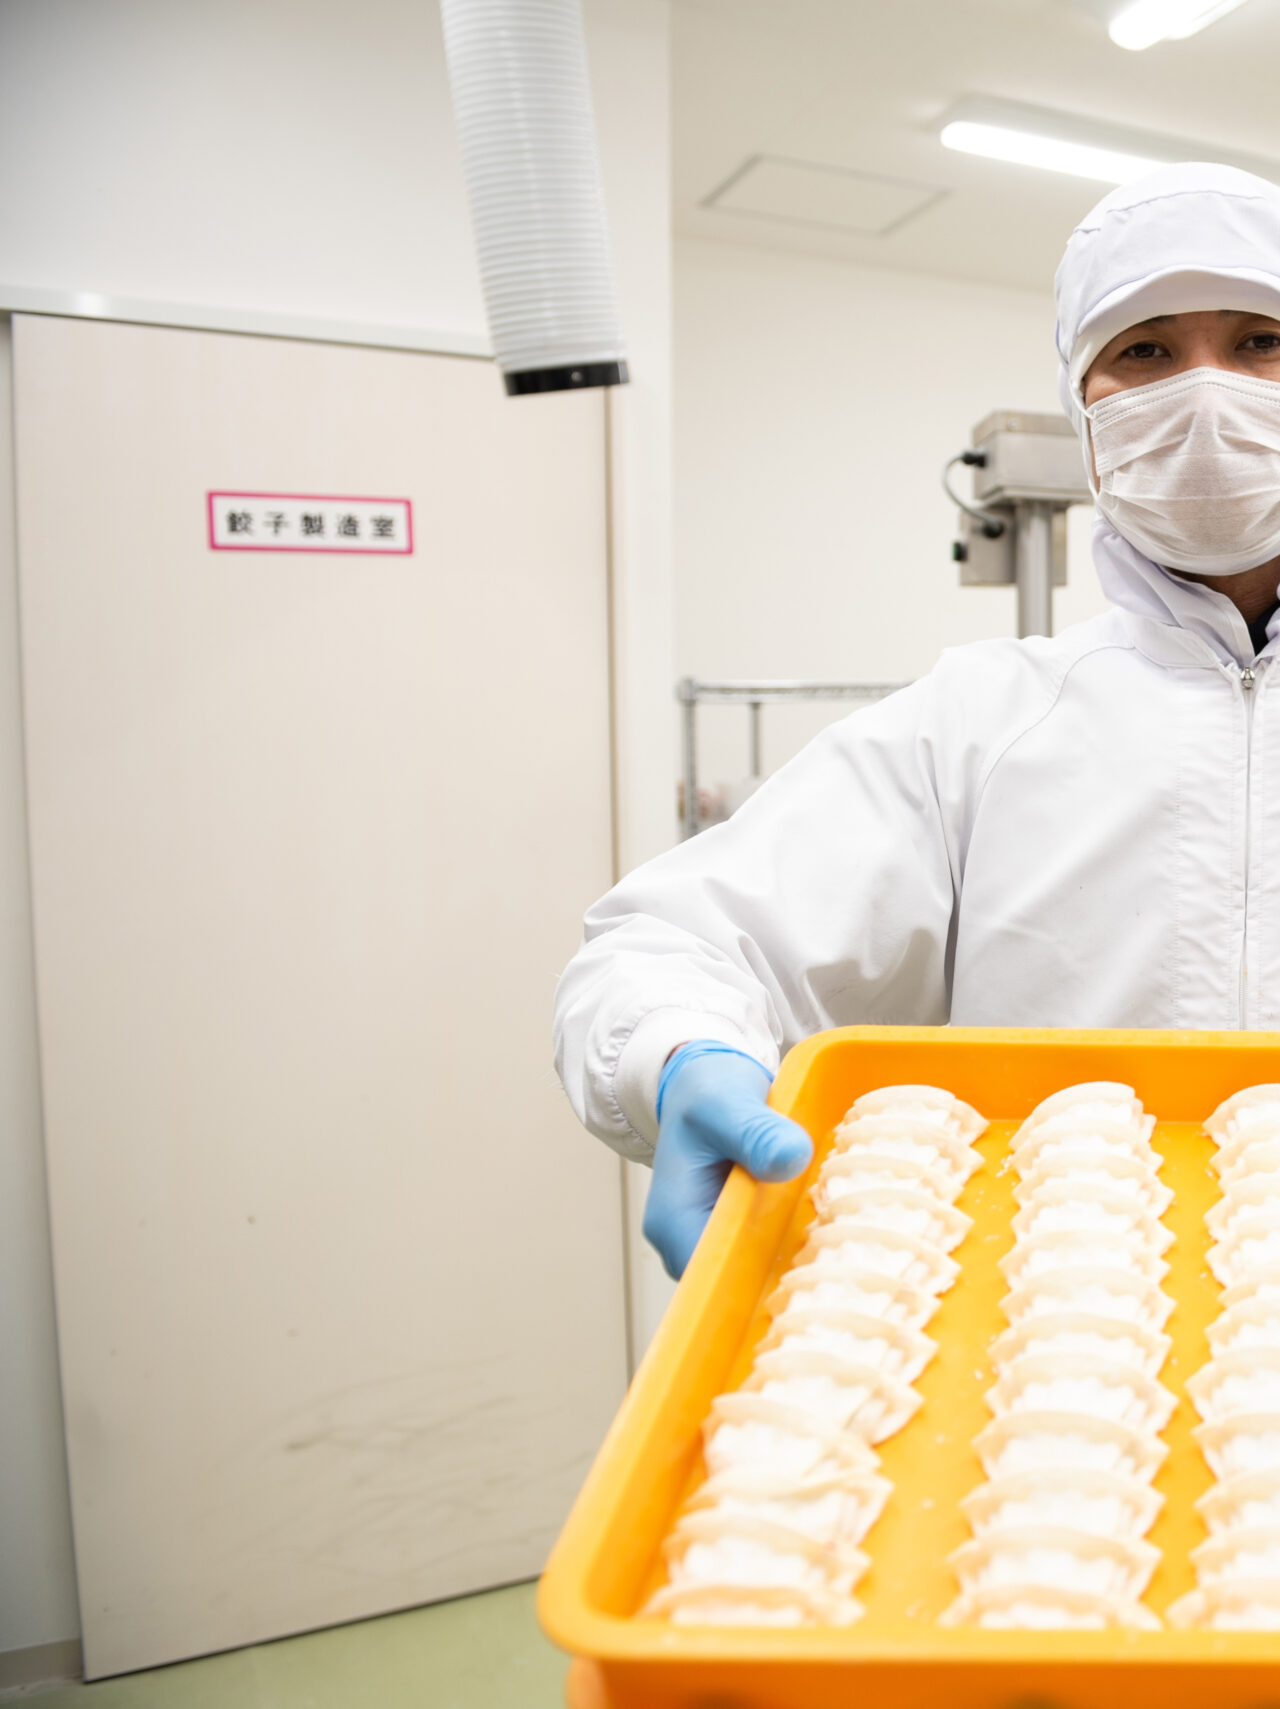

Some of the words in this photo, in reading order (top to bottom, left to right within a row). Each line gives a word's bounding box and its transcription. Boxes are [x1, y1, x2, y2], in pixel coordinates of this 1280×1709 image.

[226, 510, 395, 538] 餃子製造室
